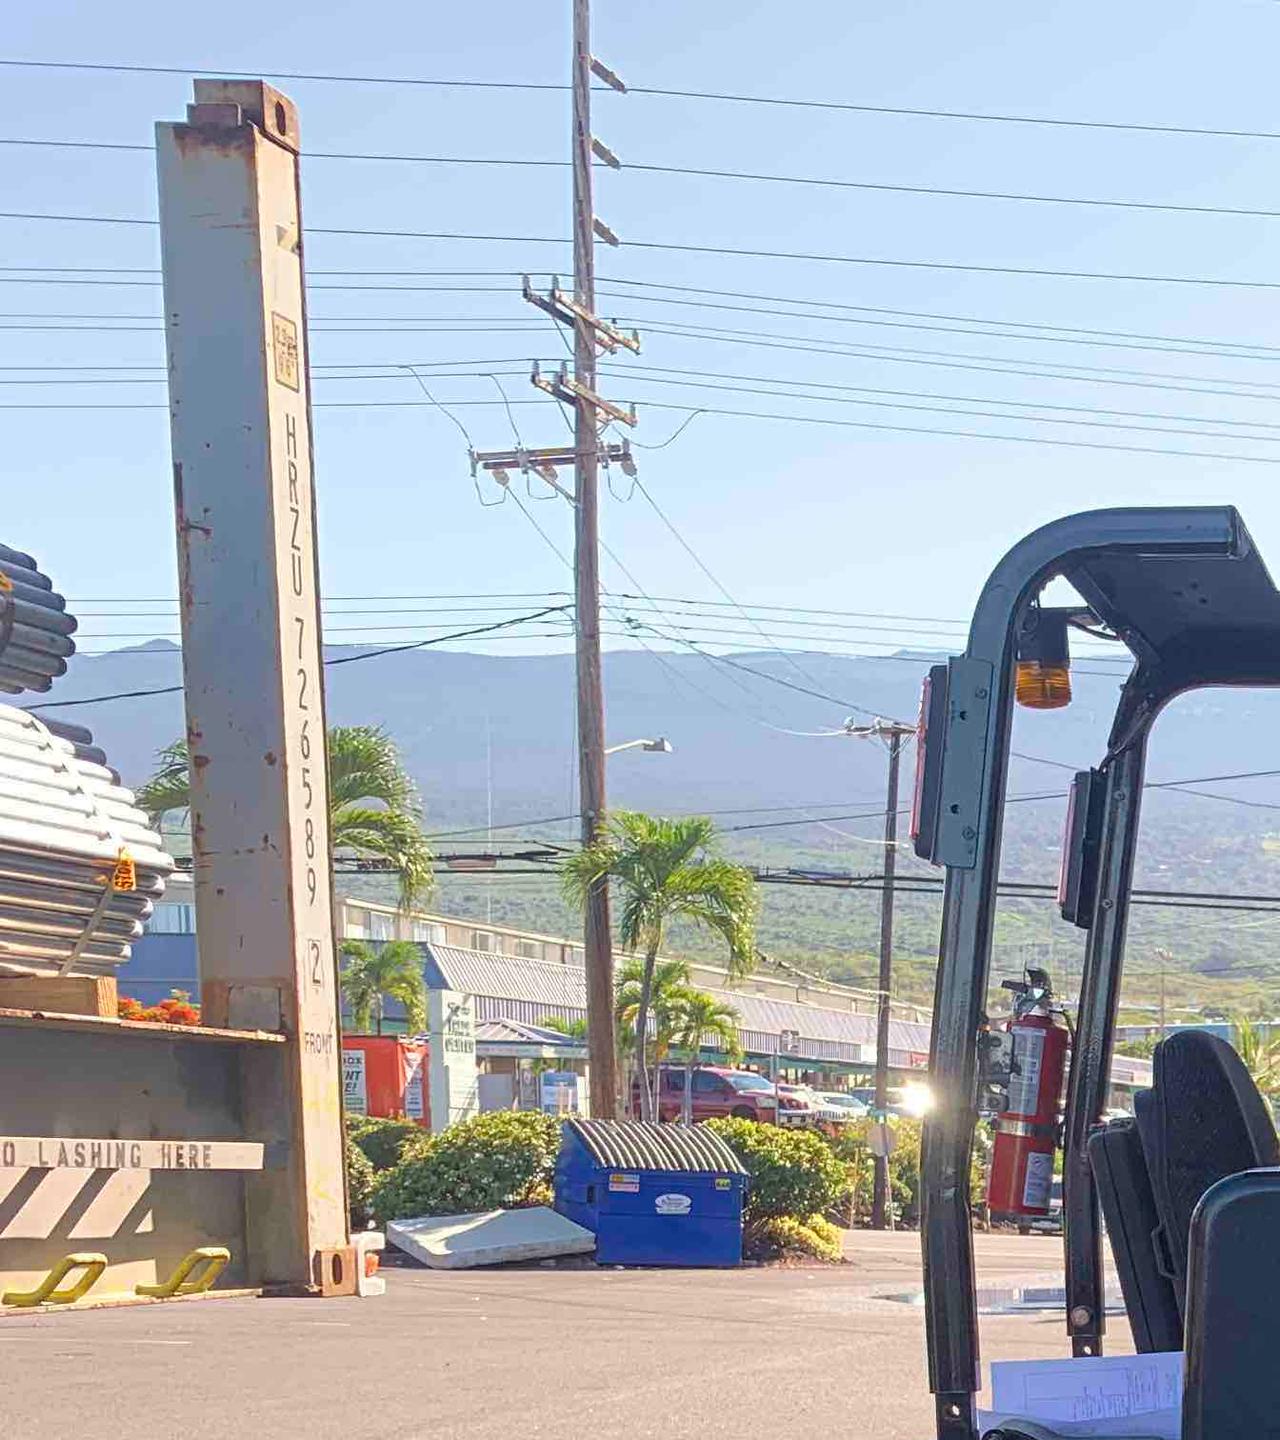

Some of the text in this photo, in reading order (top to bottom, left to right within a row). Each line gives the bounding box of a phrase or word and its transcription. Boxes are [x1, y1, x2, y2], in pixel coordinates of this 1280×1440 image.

[286, 413, 303, 597] HRZU
[304, 1033, 333, 1055] FRONT
[38, 1141, 141, 1168] LASHING
[161, 1143, 212, 1168] HERE
